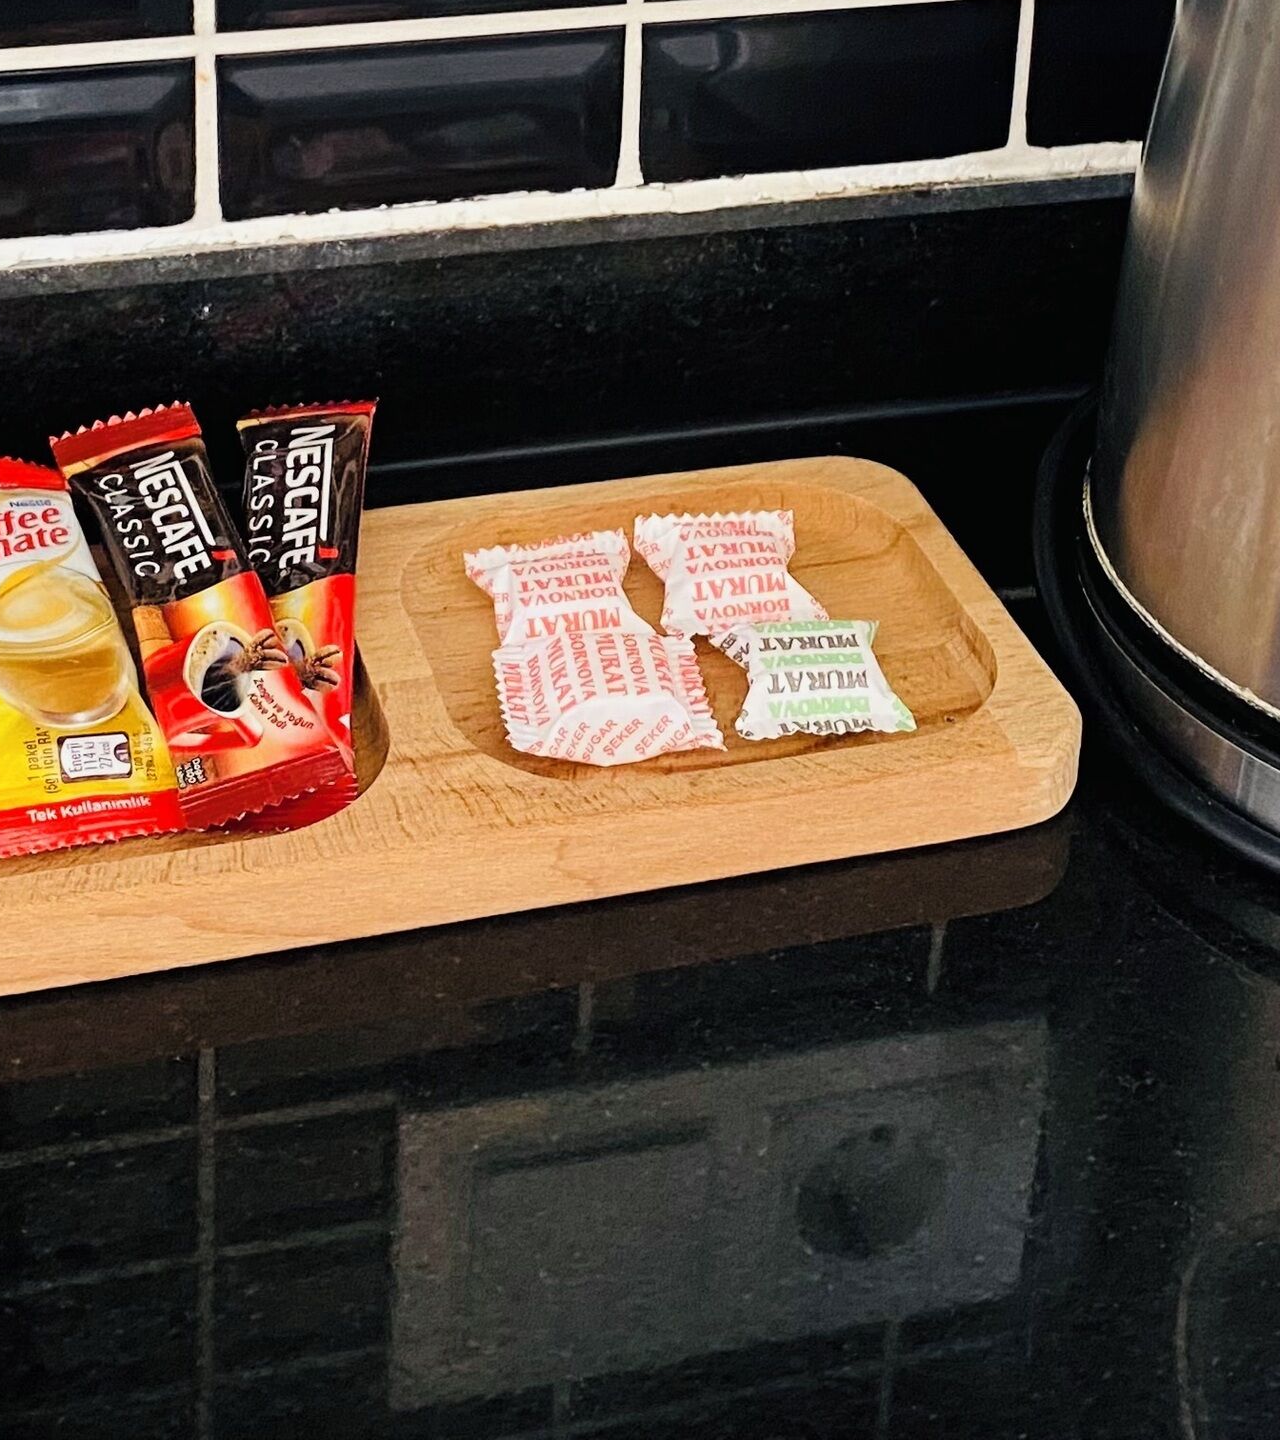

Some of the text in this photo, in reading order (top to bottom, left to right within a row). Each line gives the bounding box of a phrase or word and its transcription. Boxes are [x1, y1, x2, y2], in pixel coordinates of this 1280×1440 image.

[248, 439, 277, 563] CLASSIC
[98, 473, 161, 577] CLASSIC
[685, 541, 777, 561] MURAT
[686, 556, 784, 575] BORNOVA
[513, 558, 609, 576] BORNOVA
[519, 571, 613, 593] MURAT
[519, 587, 617, 606] BORNOVA
[693, 571, 788, 602] MURAT
[526, 607, 621, 638] MURAT
[694, 598, 790, 620] BORNOVA
[759, 633, 859, 652] MURAT
[546, 637, 577, 713] MURAT
[569, 633, 597, 701] BORNOVA
[596, 633, 627, 696] MURAT
[502, 663, 529, 724] MURAT
[527, 654, 550, 726] BORNOVA
[678, 654, 711, 715] MURAT
[767, 669, 869, 694] MURAT
[566, 721, 591, 759] EKER
[581, 718, 618, 761] SUGAR
[98, 758, 113, 769] 27
[26, 796, 152, 823] Tek Kullanımlık
